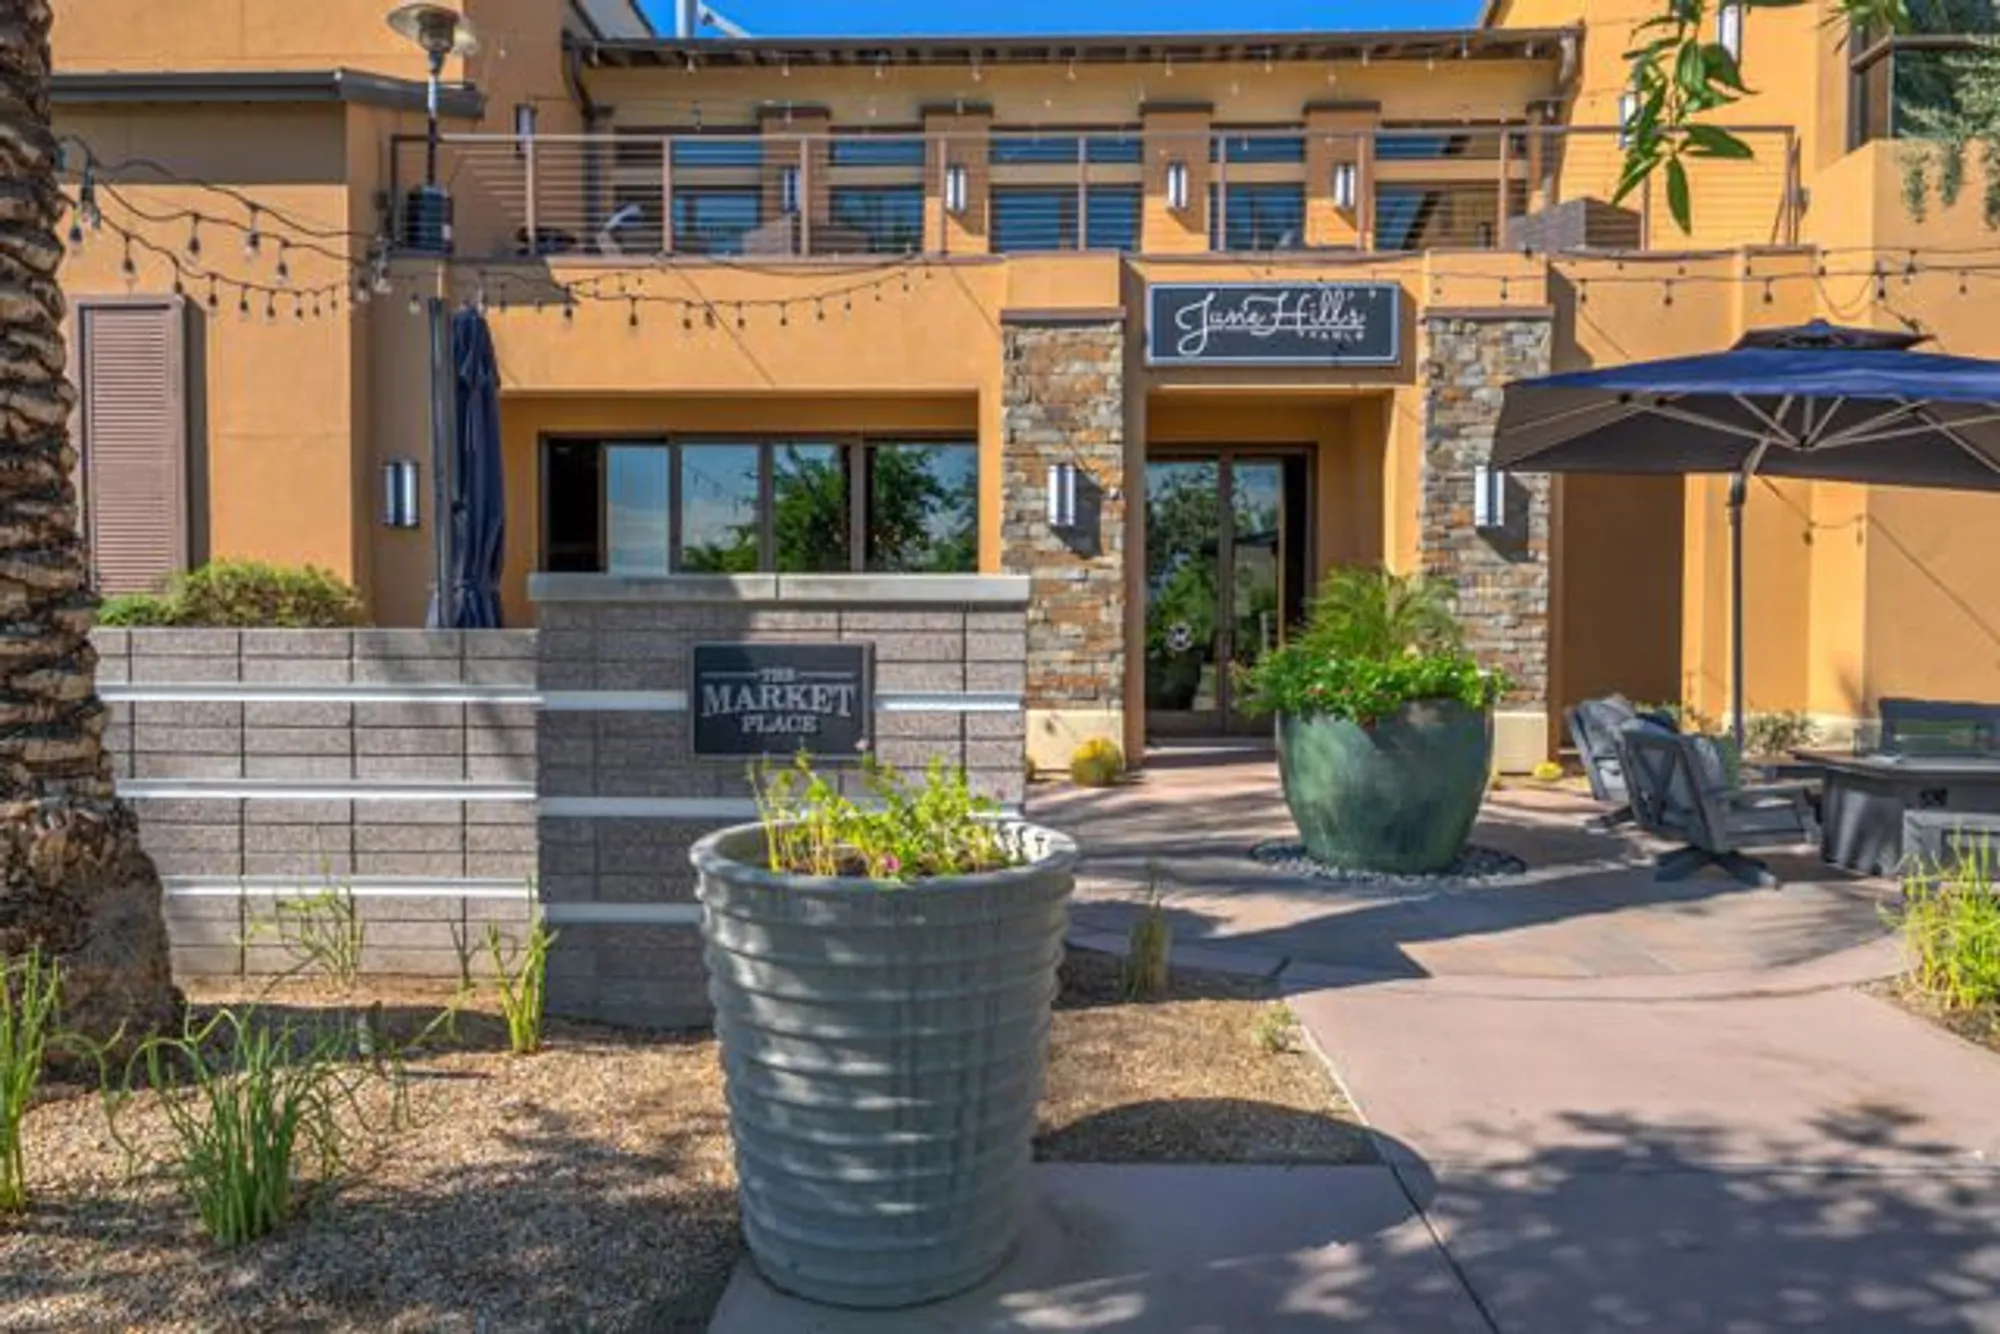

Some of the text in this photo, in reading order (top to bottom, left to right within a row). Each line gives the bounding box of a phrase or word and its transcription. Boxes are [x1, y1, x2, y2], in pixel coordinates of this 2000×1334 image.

[760, 667, 795, 682] THE
[701, 683, 857, 717] MARKET
[741, 715, 817, 733] PLACE
